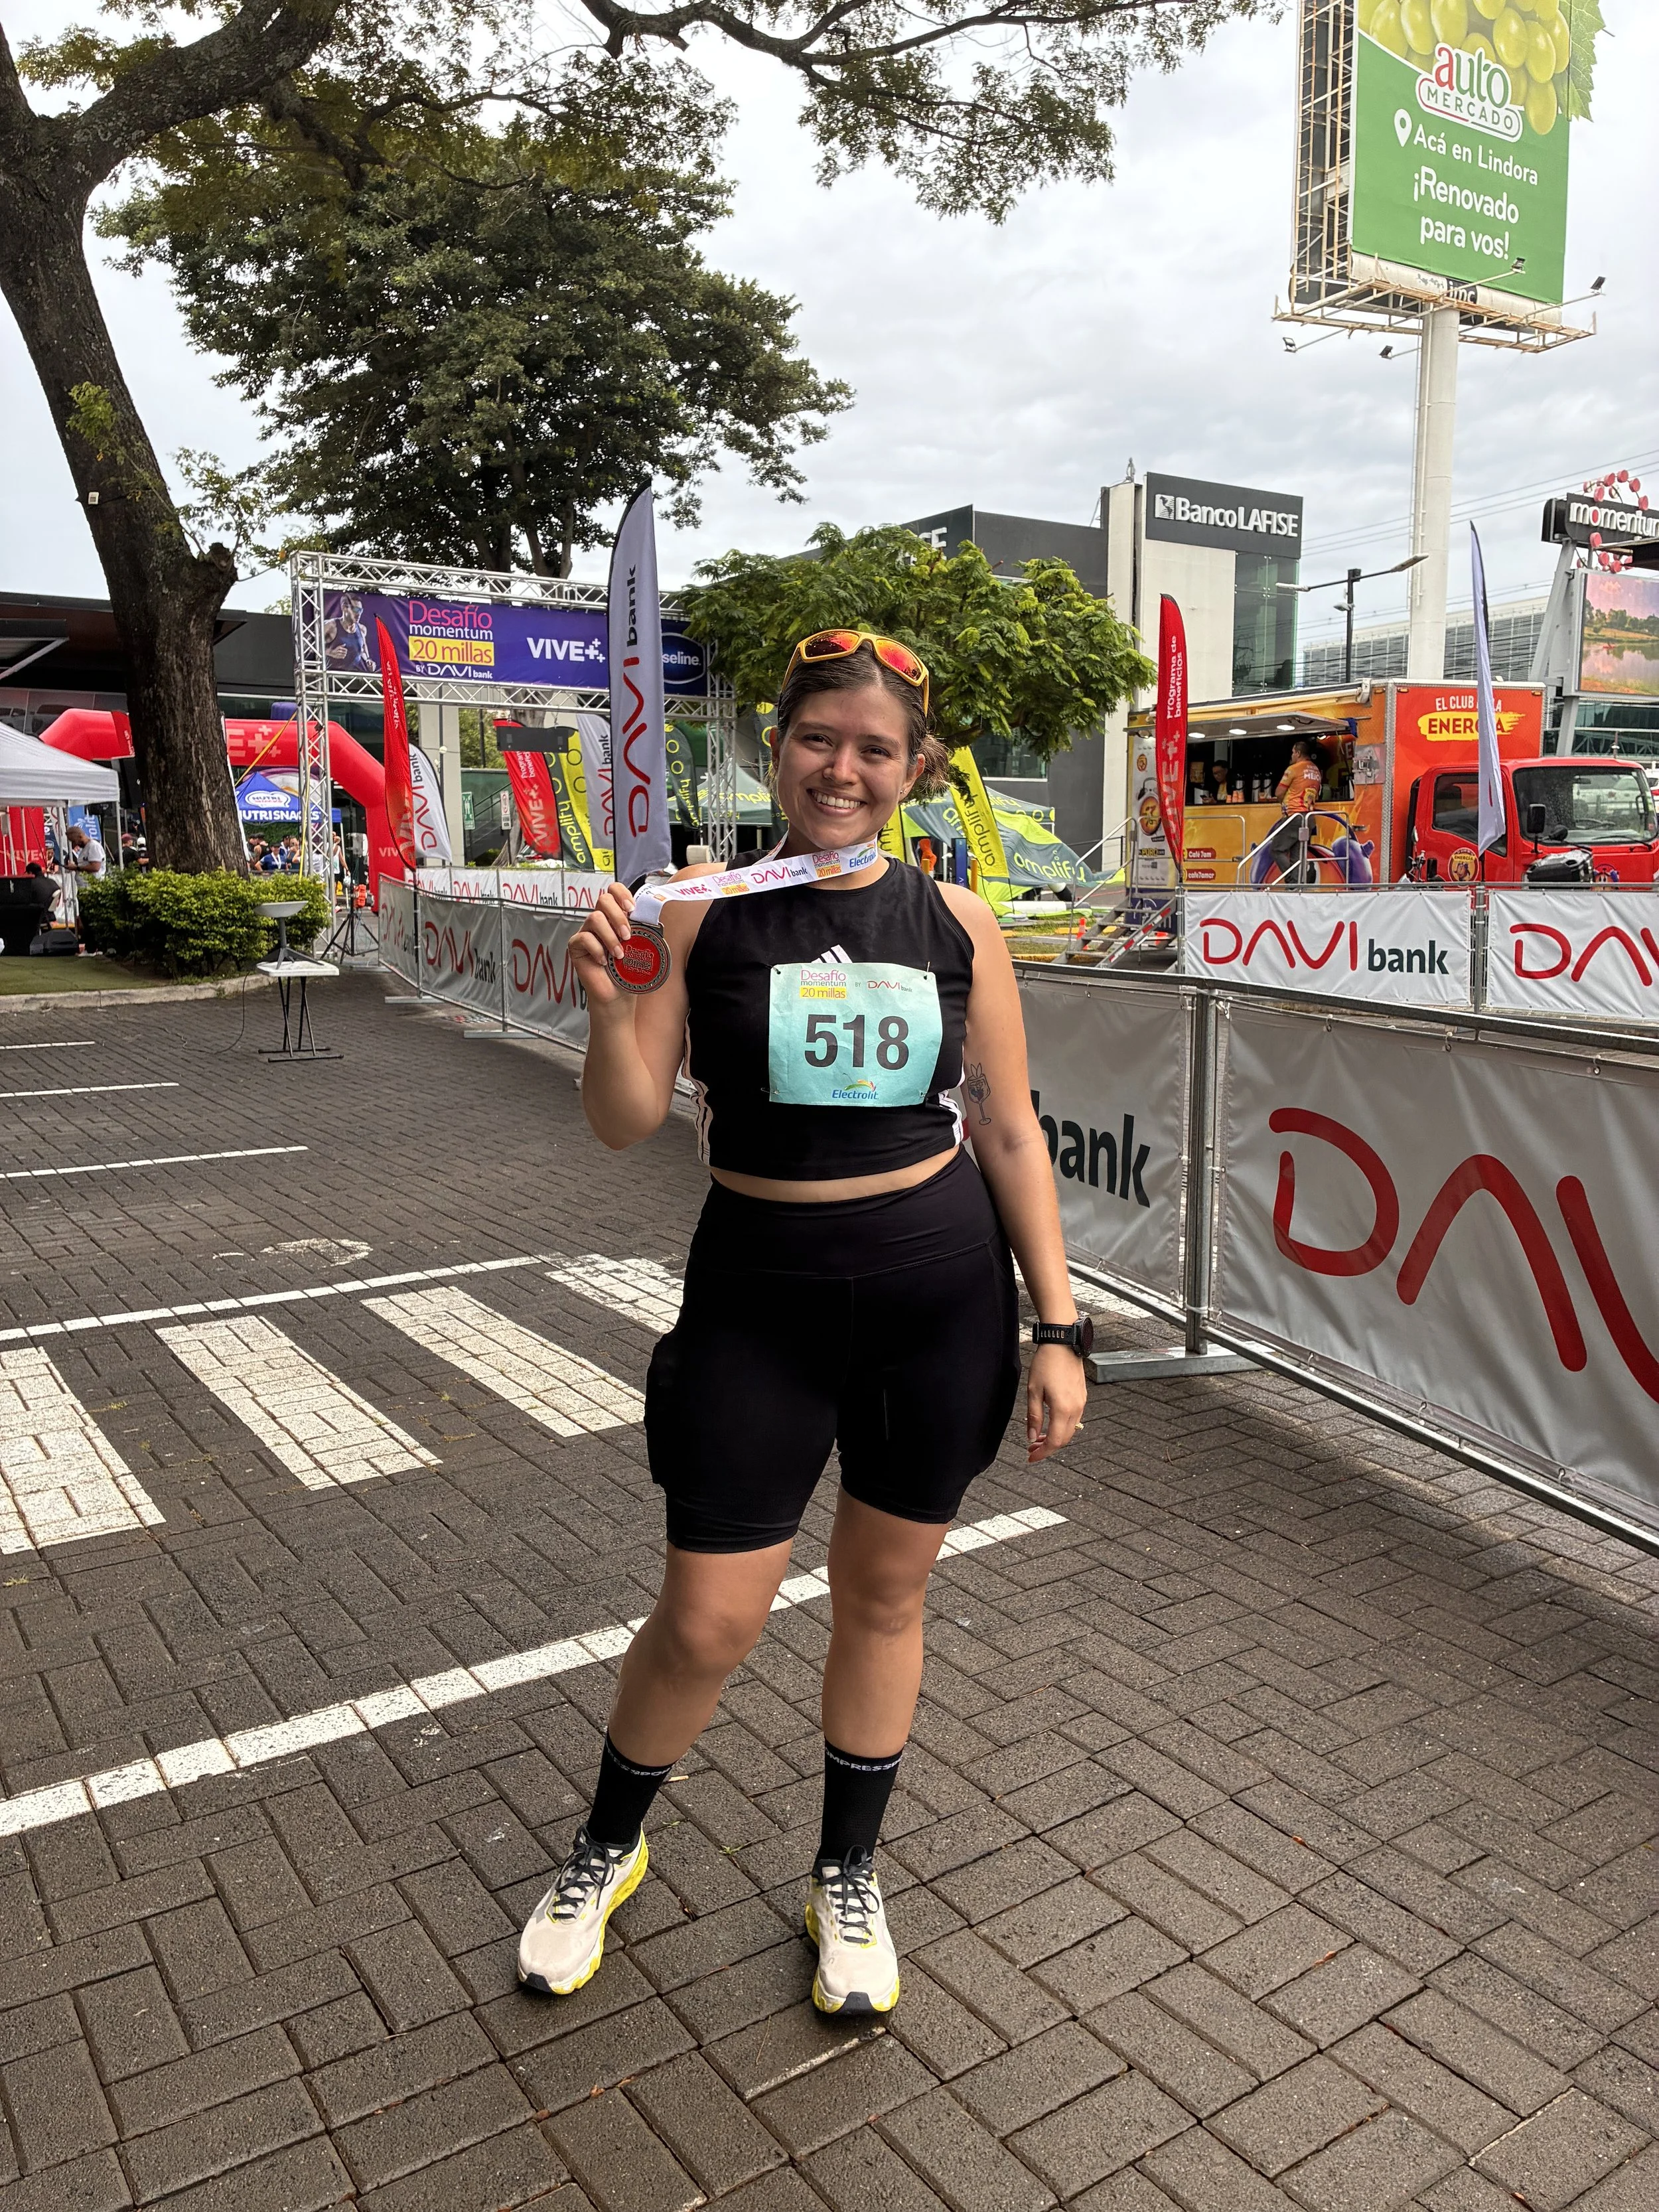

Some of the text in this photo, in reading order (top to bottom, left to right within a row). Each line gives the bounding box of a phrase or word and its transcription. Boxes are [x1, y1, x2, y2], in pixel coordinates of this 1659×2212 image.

[1435, 47, 1508, 108] auto
[1427, 86, 1513, 129] MERCADO
[1413, 124, 1538, 186] Acá en Lindora
[1413, 165, 1519, 224] ¡Renovado
[1420, 216, 1509, 260] para vos!
[409, 600, 492, 628] Desafío
[409, 624, 492, 640] momentum
[413, 639, 492, 664] 20 millas
[662, 651, 700, 666] seline
[415, 664, 492, 680] BY DAVI bank
[1166, 635, 1177, 719] Programa de
[1174, 652, 1184, 718] beneficios
[622, 564, 650, 838] DAVI bank
[1435, 698, 1448, 711] EL
[1449, 695, 1475, 709] CLUB
[1428, 717, 1506, 735] ENERA
[409, 753, 437, 849] DAVI bank
[558, 800, 586, 863] amplify
[751, 867, 808, 883] DAVI bank
[818, 866, 841, 877] 20 millas
[1014, 852, 1086, 883] amplify
[503, 883, 538, 904] DAVI
[568, 886, 605, 908] DAV
[425, 921, 496, 984] DAVI bank
[1200, 918, 1449, 974] DAVI bank
[1509, 923, 1659, 986] DA
[801, 970, 846, 981] Desafío
[867, 980, 900, 990] DAVI
[802, 988, 846, 998] 20 millas
[804, 1014, 909, 1070] 518
[832, 1090, 879, 1099] Electrolit
[1031, 1090, 1151, 1208] bank
